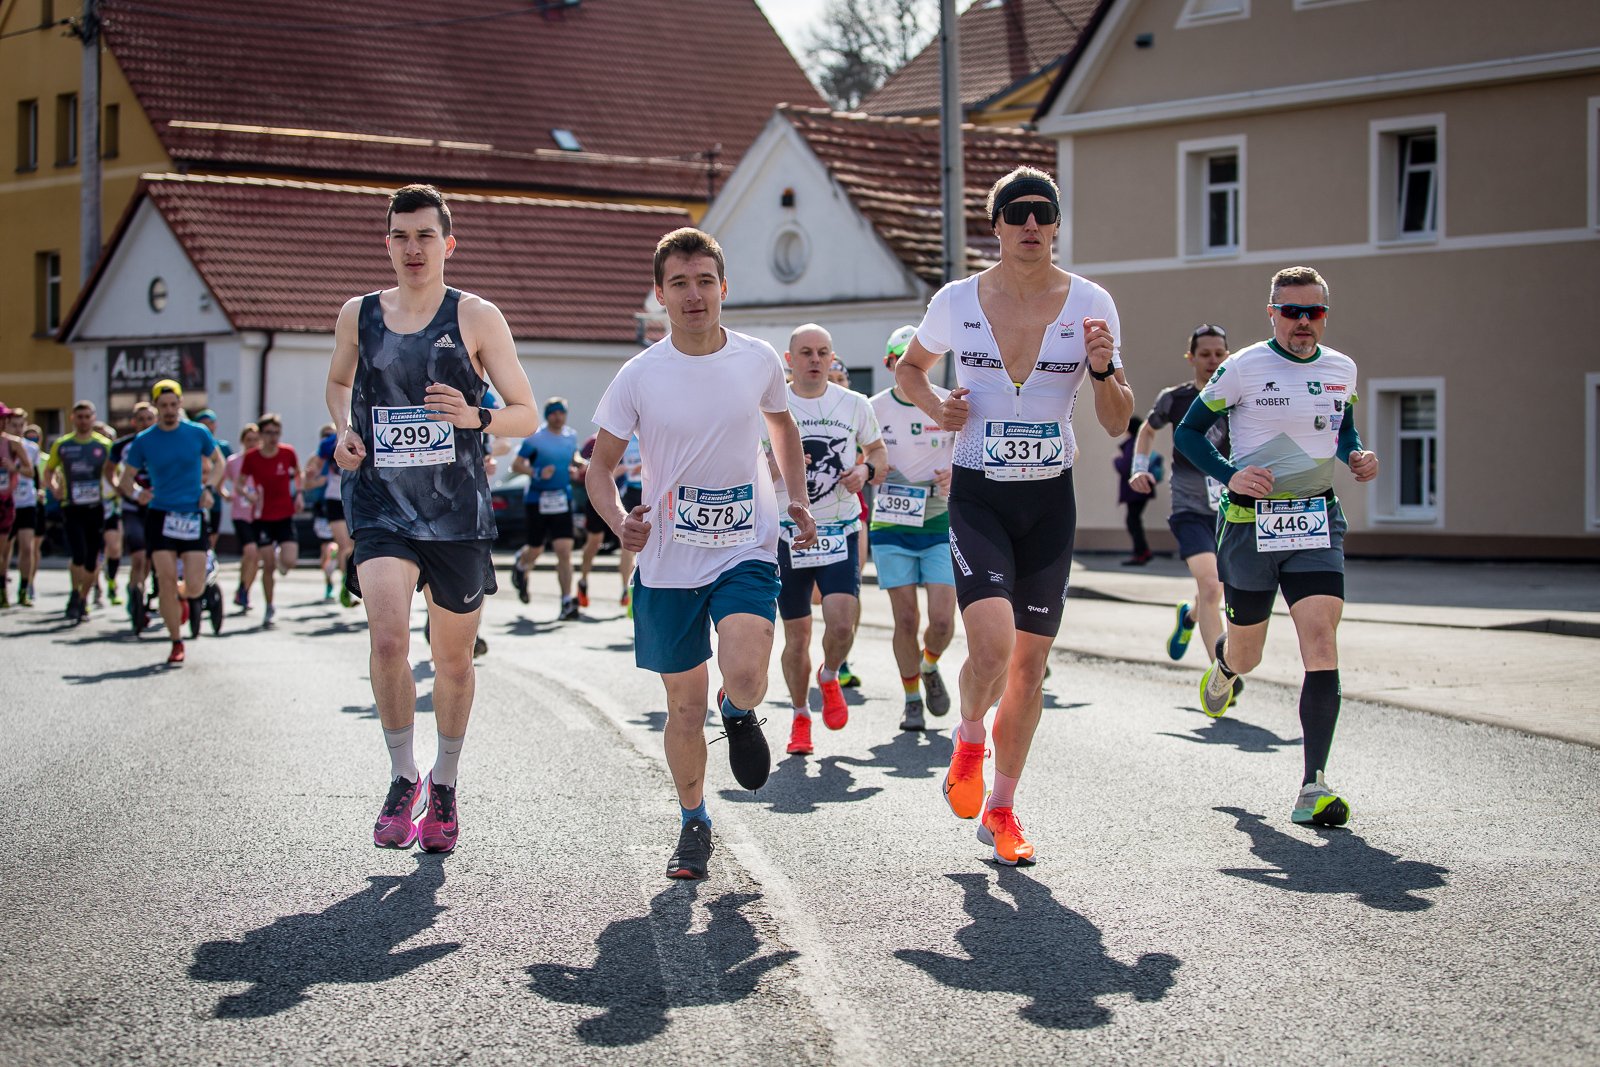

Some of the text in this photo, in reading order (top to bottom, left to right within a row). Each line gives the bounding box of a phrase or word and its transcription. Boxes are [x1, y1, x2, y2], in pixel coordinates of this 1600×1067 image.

[1255, 397, 1290, 406] ROBERT
[390, 425, 431, 446] 299
[1003, 440, 1042, 460] 331
[886, 496, 910, 511] 399
[696, 506, 734, 527] 578
[1273, 515, 1308, 533] 446
[807, 538, 830, 552] 49
